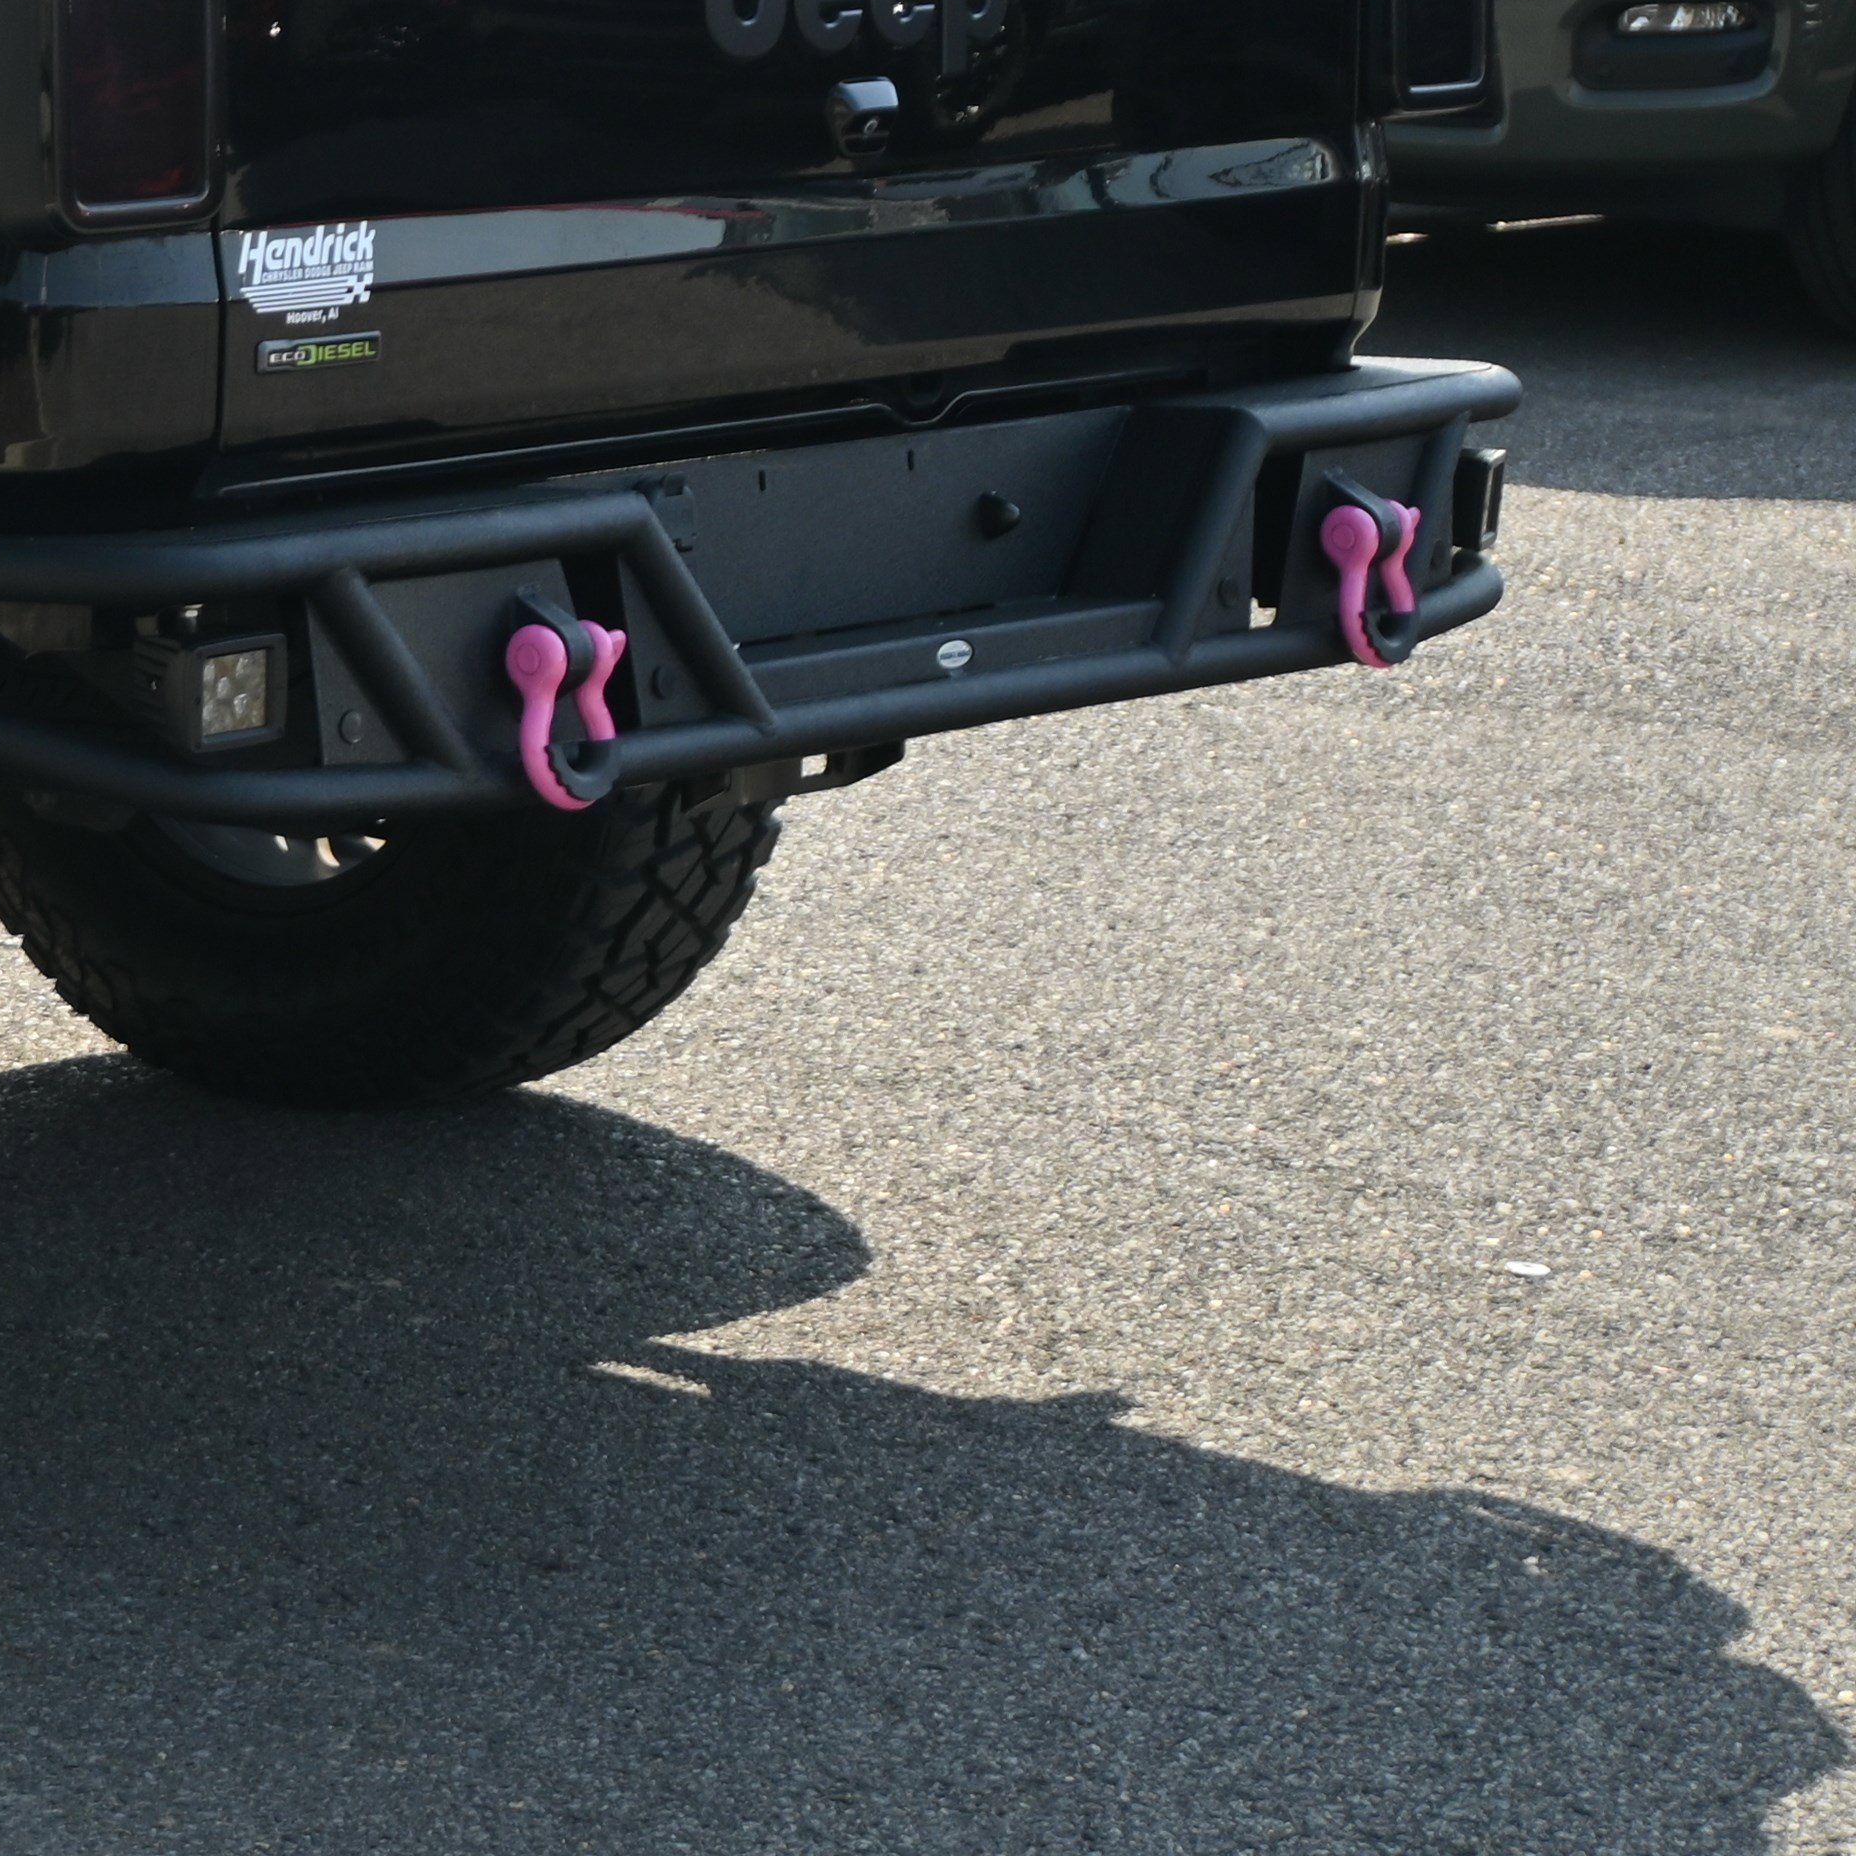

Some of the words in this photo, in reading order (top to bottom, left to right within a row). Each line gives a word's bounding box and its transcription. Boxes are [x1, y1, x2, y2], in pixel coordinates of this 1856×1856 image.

[239, 220, 376, 285] Hendrick
[262, 267, 303, 284] CHRYSLER
[304, 264, 332, 279] DODGE
[333, 262, 353, 276] JEEP
[353, 260, 374, 273] RAM
